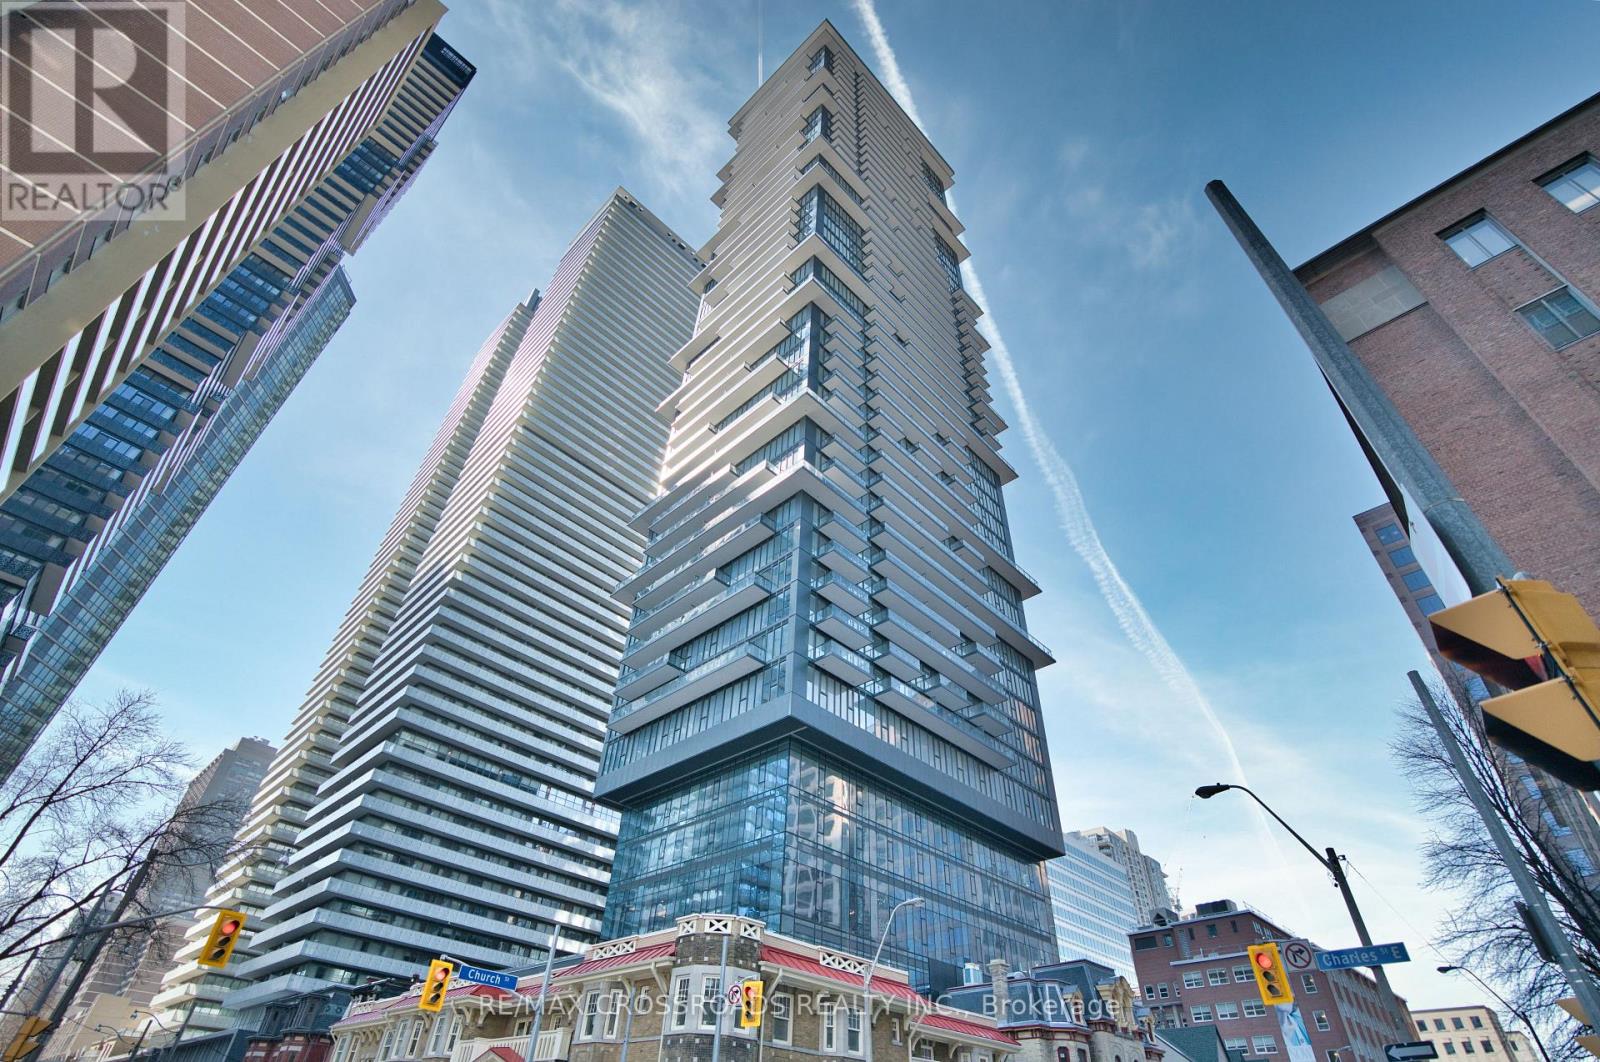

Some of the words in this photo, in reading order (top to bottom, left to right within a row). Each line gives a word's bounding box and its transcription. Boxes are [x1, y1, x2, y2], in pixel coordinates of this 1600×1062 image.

[1322, 950, 1378, 967] Charles
[1391, 946, 1402, 959] E
[468, 968, 501, 985] Church
